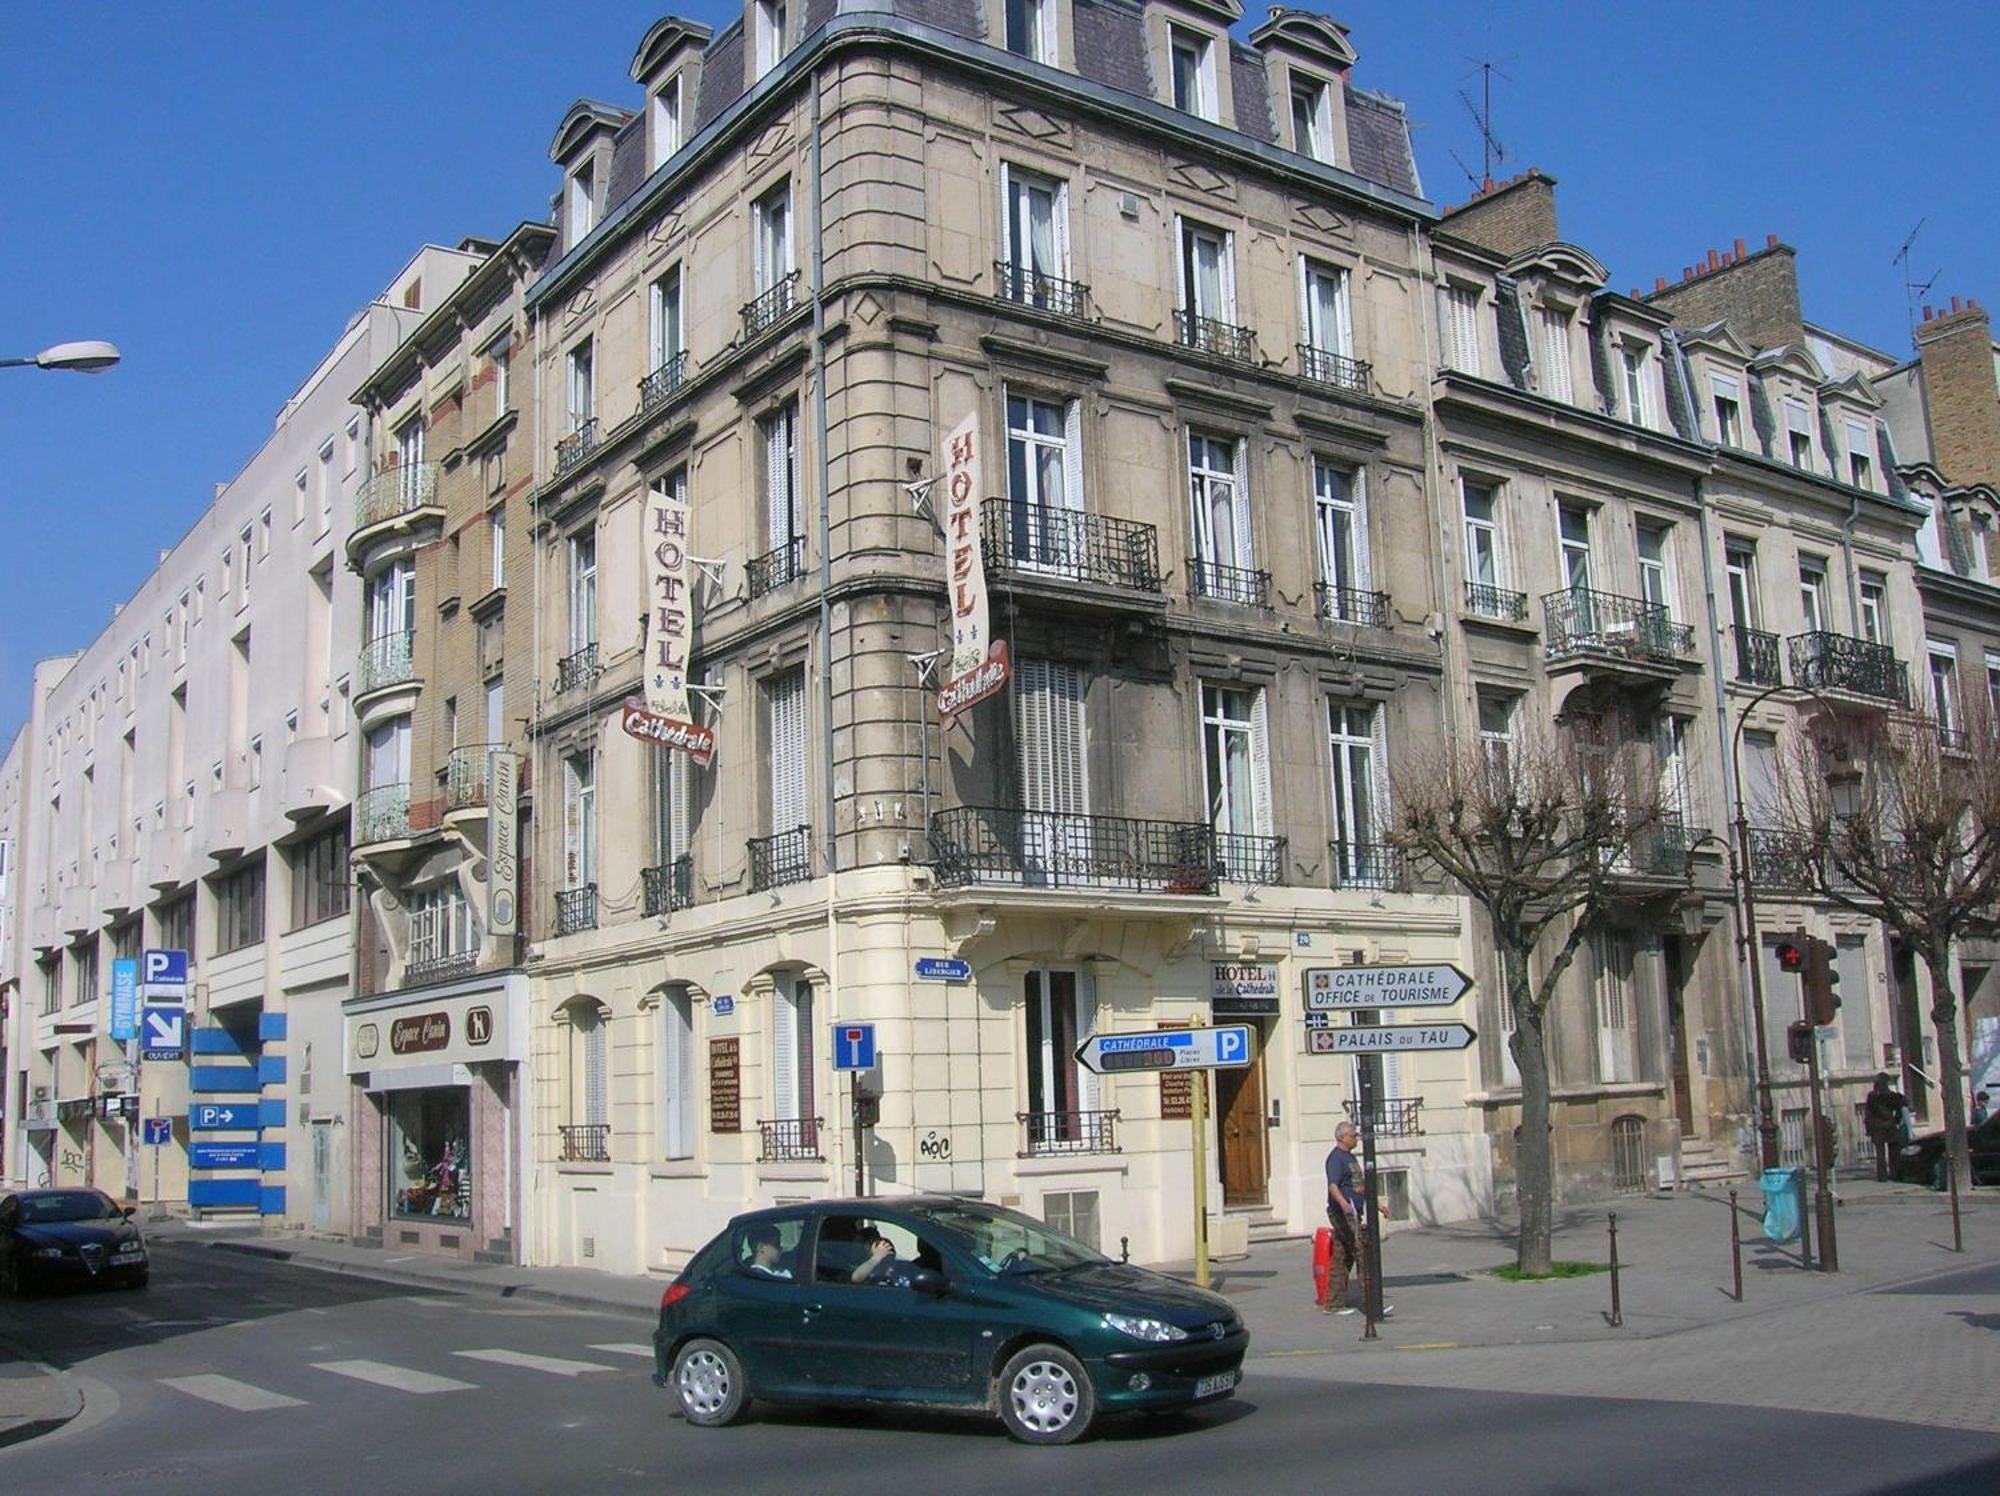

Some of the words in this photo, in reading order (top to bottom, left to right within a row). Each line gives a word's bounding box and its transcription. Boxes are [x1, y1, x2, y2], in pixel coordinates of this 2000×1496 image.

[950, 430, 977, 618] HOTEL
[653, 507, 686, 672] HOTEL
[495, 760, 514, 816] Canin
[494, 821, 515, 882] Espace
[147, 953, 169, 982] P
[935, 961, 950, 969] RUE
[1214, 966, 1267, 981] HOTEL
[1335, 970, 1435, 987] CATHÉDRALE
[115, 971, 134, 1031] GYMNASE
[1315, 990, 1360, 1005] OFFICE
[1382, 987, 1450, 1002] TOURISME
[393, 1021, 421, 1051] Espace
[421, 1015, 447, 1045] Canin
[1103, 1037, 1170, 1051] CATHÉDRALE
[1338, 1033, 1393, 1047] PALAIS
[1400, 1036, 1413, 1044] DU
[1420, 1031, 1449, 1043] TAU
[147, 1052, 180, 1060] OUVERT
[1221, 1033, 1240, 1059] P
[204, 1109, 216, 1123] P
